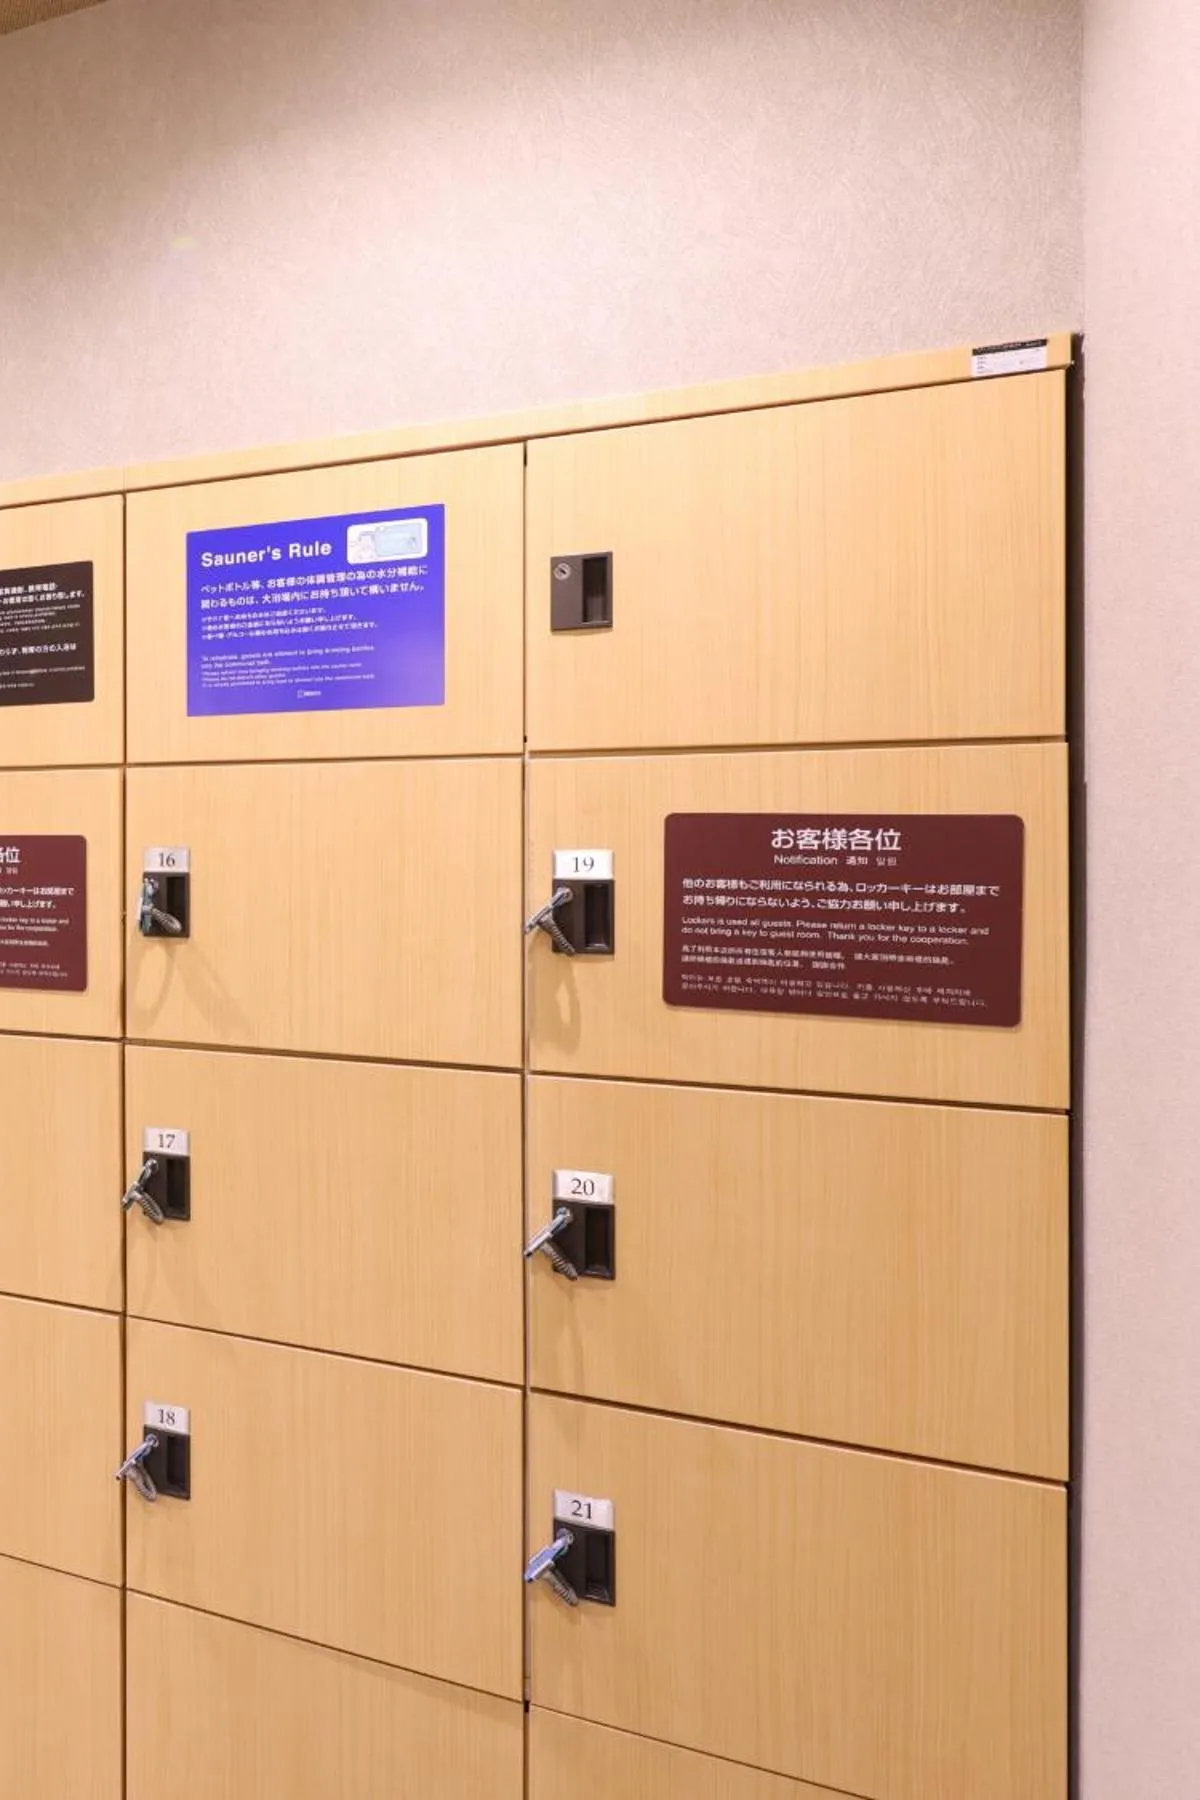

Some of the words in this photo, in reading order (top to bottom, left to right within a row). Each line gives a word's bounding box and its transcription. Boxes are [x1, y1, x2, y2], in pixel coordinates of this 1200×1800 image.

[201, 546, 281, 567] Sauner's
[289, 540, 332, 556] Rule
[771, 828, 901, 851] お客様各位
[159, 852, 175, 867] 16
[572, 856, 594, 873] 19
[774, 854, 838, 865] Notification
[727, 918, 747, 926] used
[750, 918, 759, 926] all
[158, 1134, 175, 1148] 17
[571, 1178, 595, 1196] 20
[158, 1409, 175, 1425] 18
[571, 1500, 592, 1519] 21
